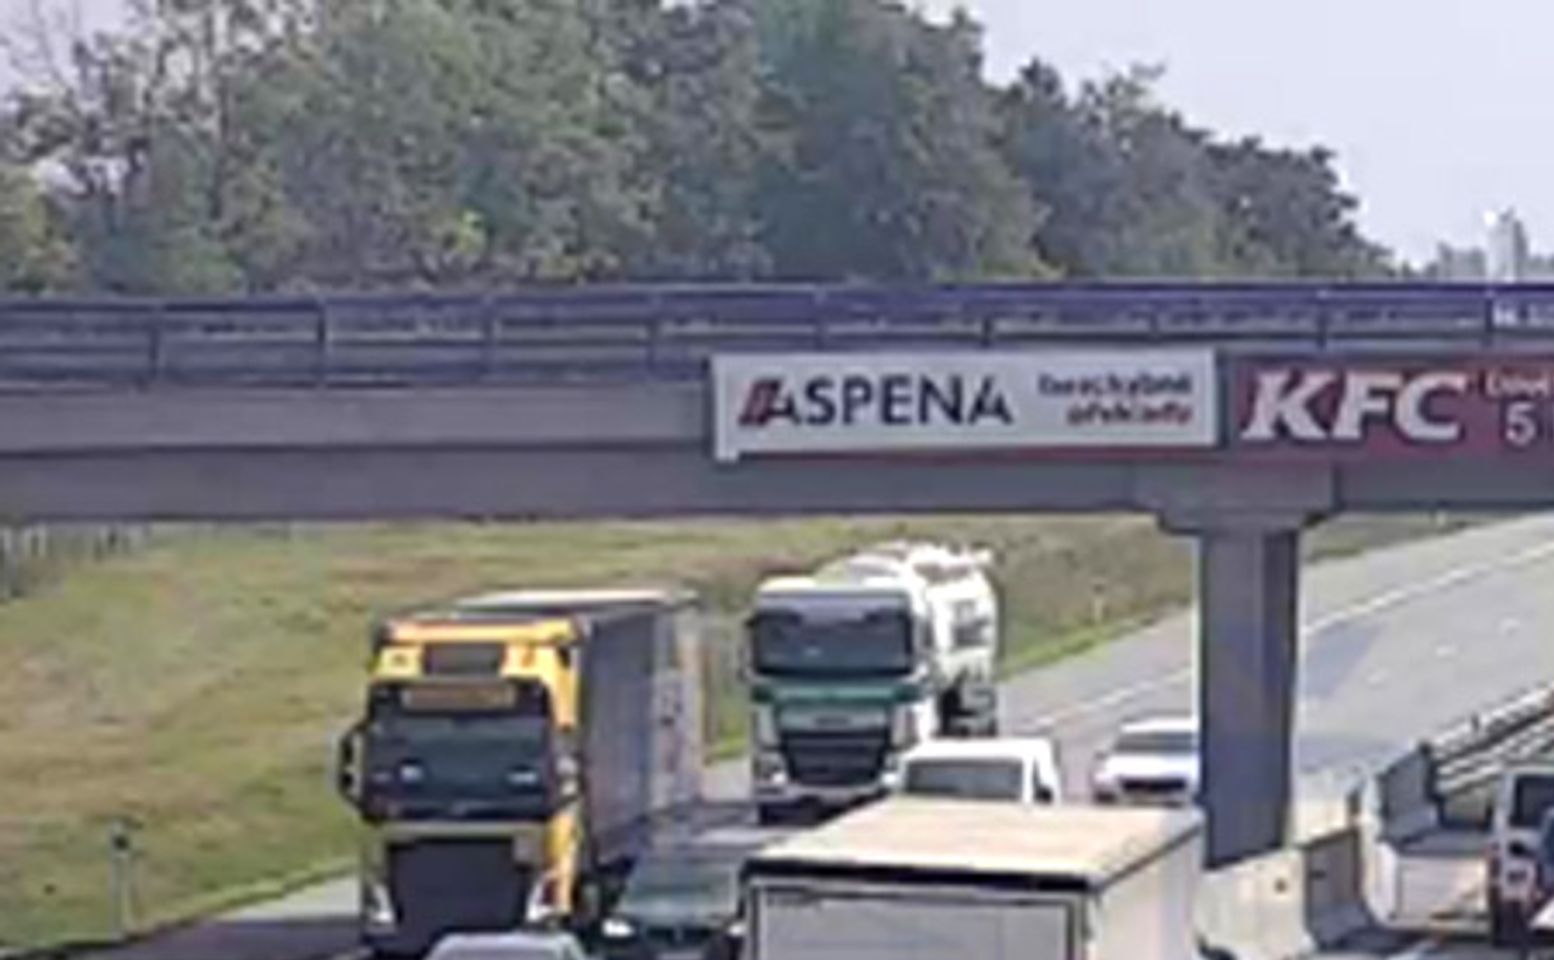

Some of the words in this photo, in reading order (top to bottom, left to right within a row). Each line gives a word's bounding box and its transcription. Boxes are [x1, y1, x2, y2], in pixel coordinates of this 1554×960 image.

[738, 374, 1013, 427] ASPENA
[1240, 370, 1468, 441] KFC
[1506, 403, 1535, 445] 5
